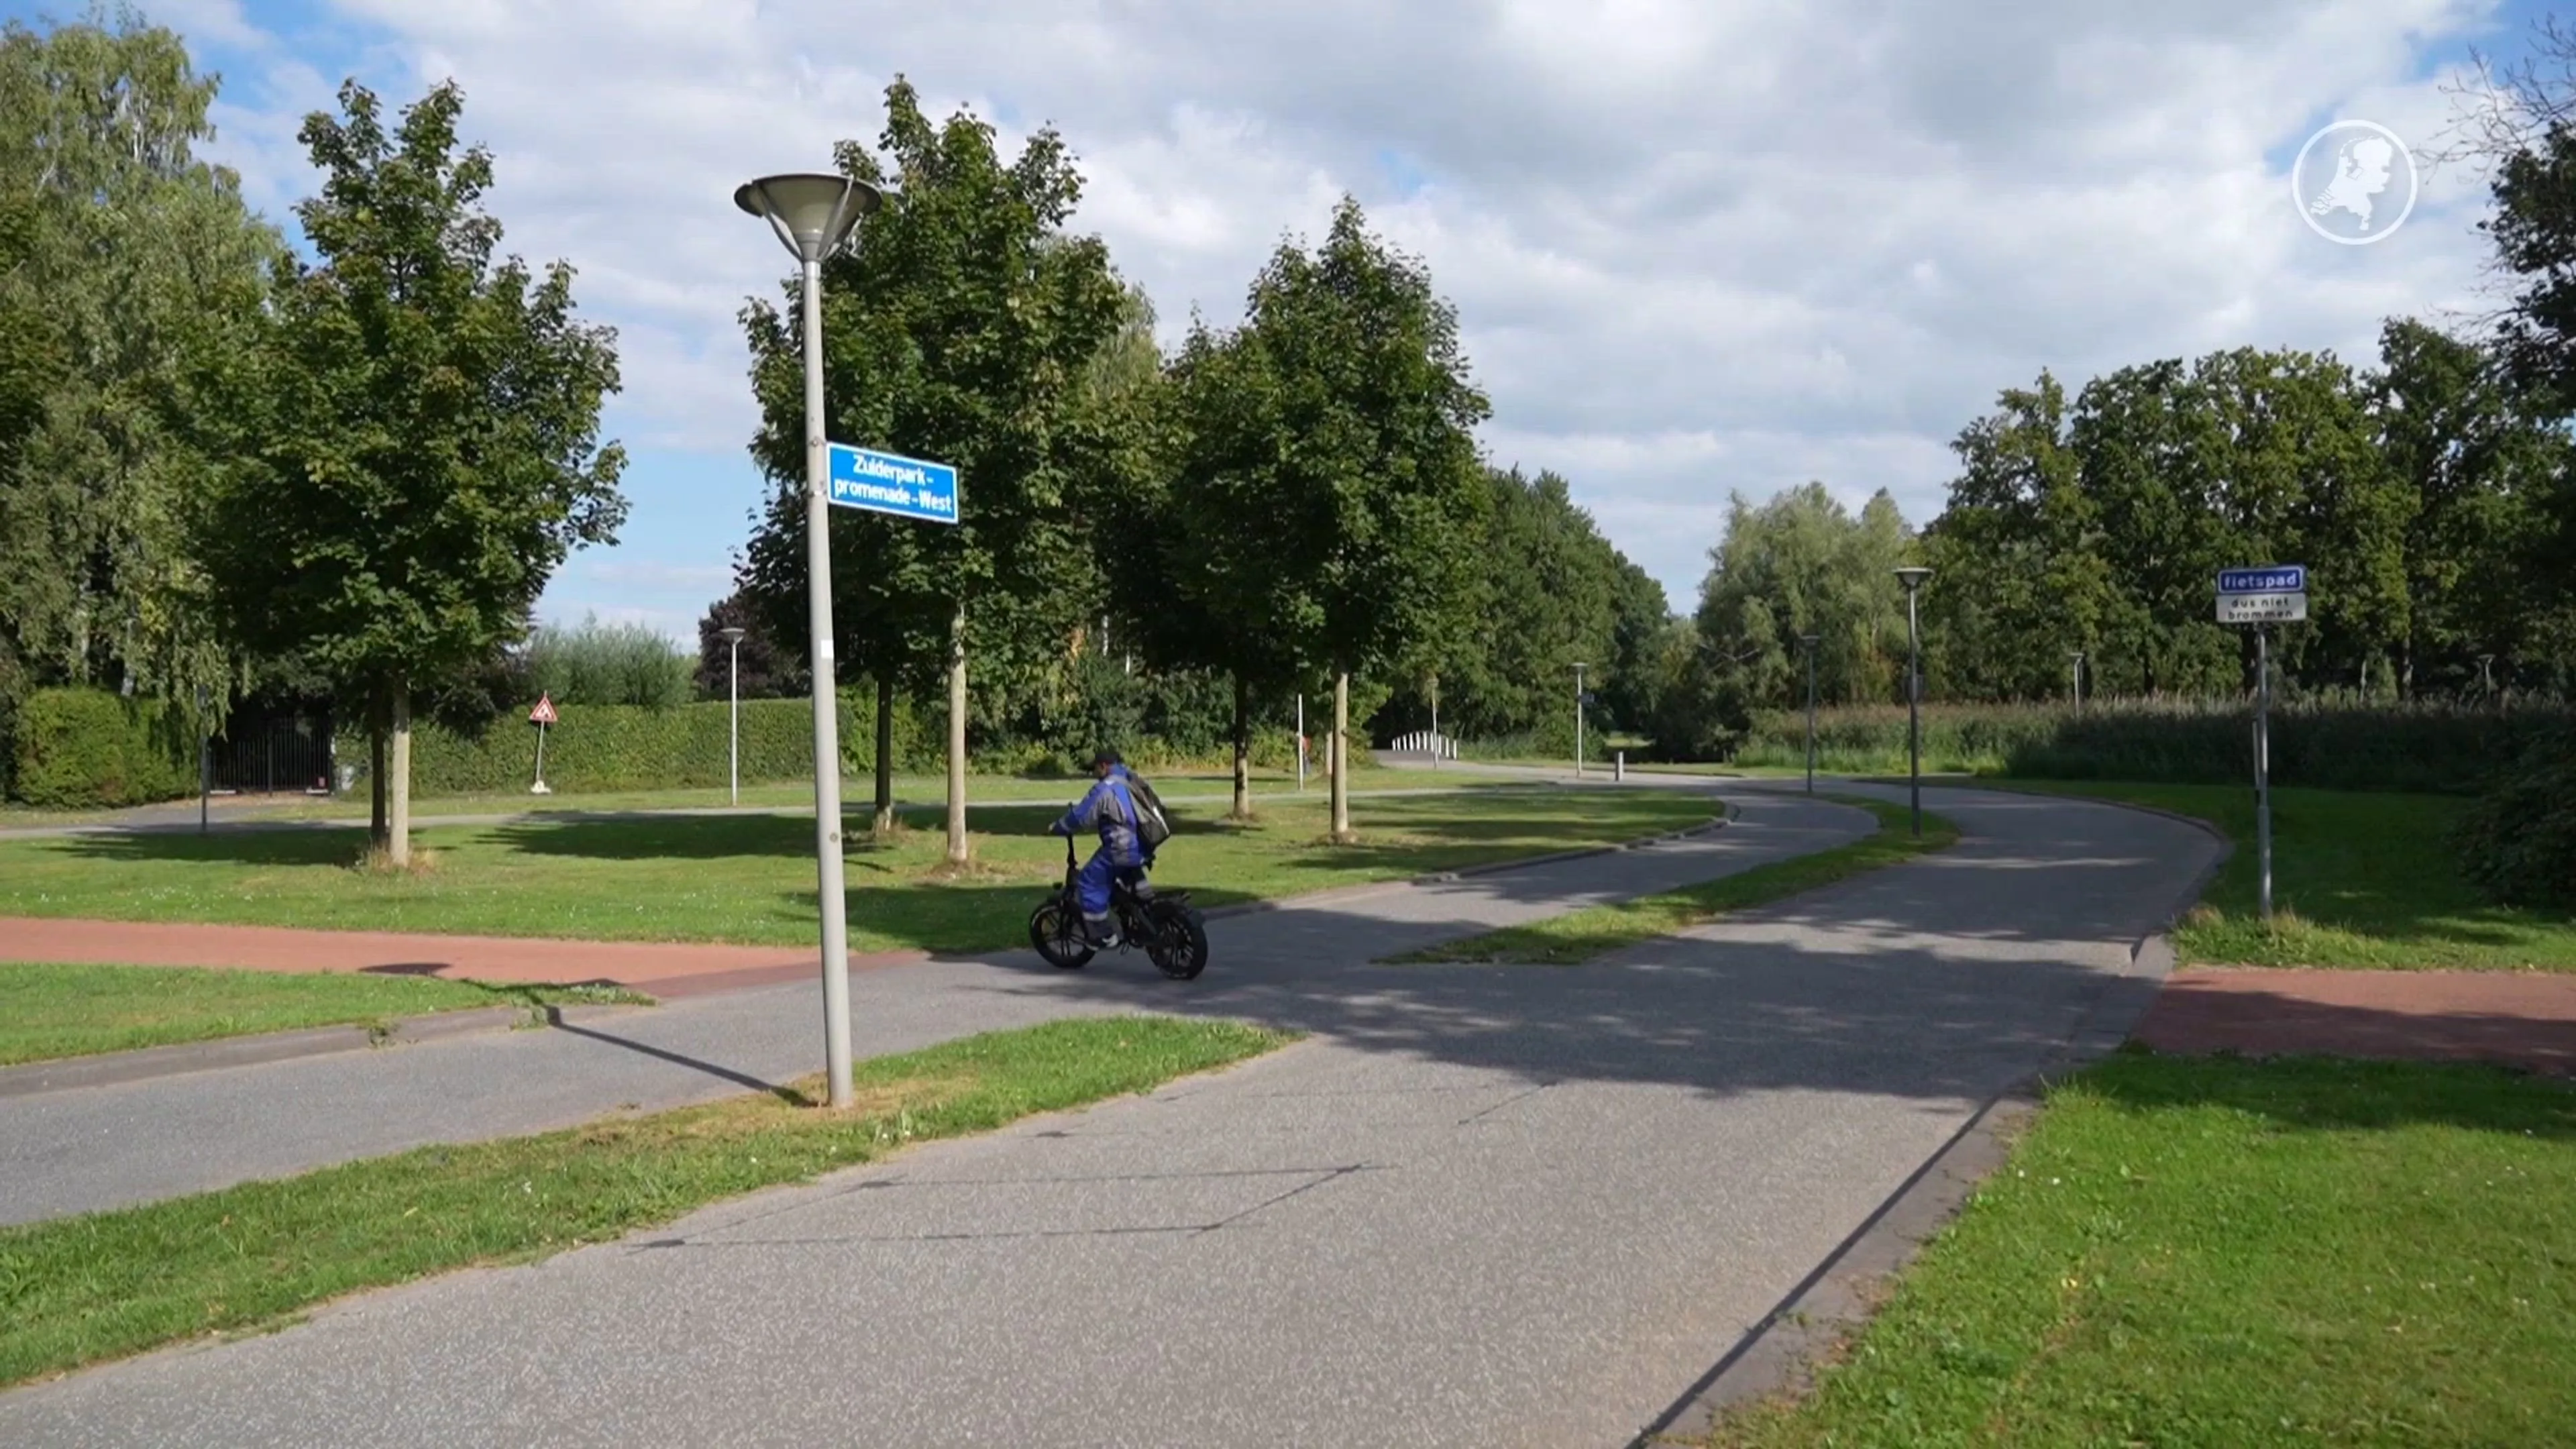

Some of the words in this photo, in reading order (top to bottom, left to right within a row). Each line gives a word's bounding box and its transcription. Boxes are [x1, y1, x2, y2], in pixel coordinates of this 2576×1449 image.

[835, 478, 953, 513] promenade-West
[2224, 573, 2297, 588] fietspad
[2231, 598, 2255, 608] dus
[2261, 597, 2289, 606] niet
[2229, 610, 2293, 619] brommen
